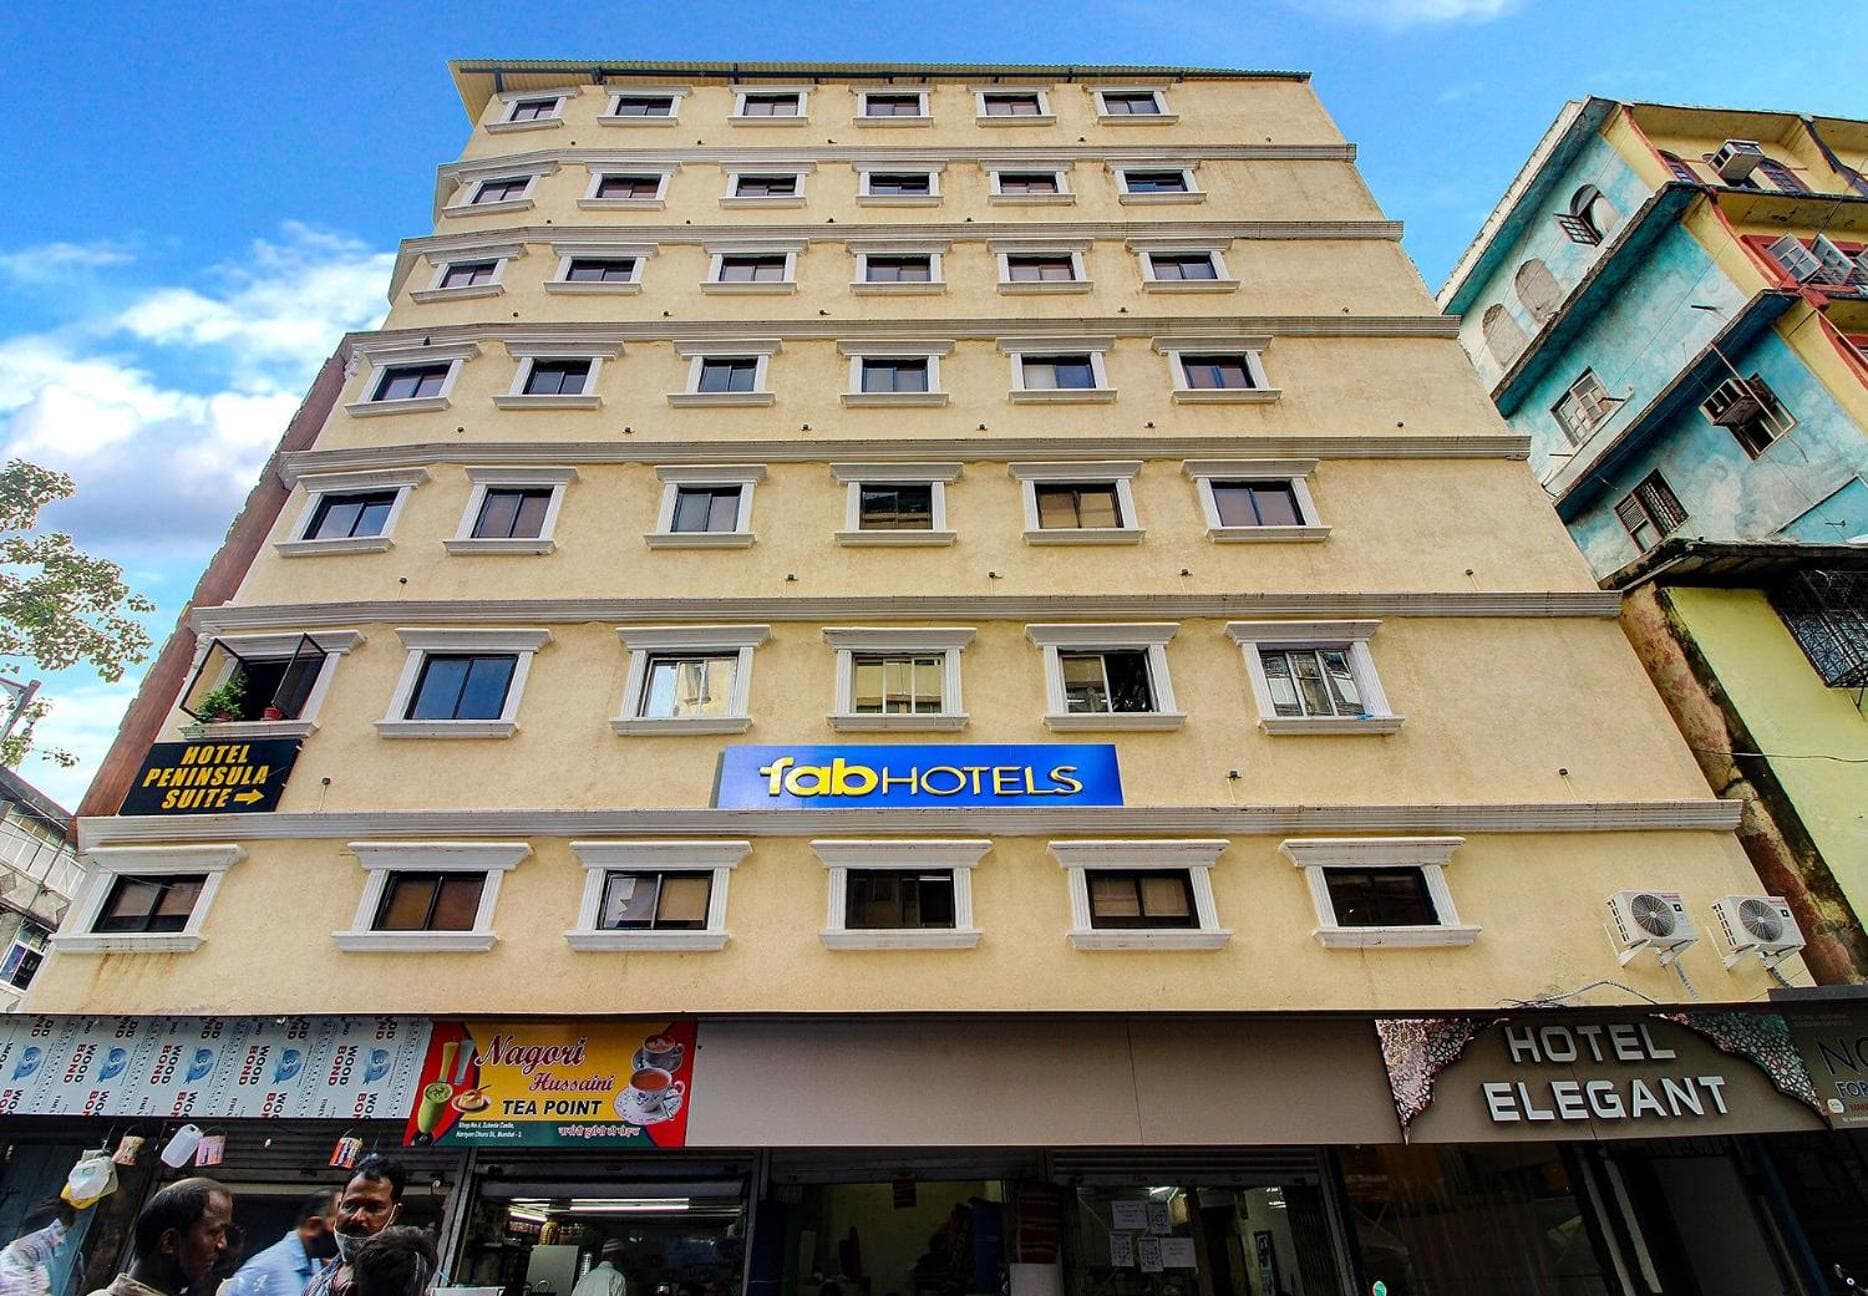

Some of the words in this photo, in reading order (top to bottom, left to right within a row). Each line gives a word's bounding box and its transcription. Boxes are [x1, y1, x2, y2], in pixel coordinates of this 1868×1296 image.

[180, 744, 250, 765] HOTEL
[142, 765, 270, 788] PENINSULA
[161, 788, 233, 809] SUITE
[63, 1043, 87, 1083] BOND
[75, 1043, 98, 1083] WOOD
[475, 1033, 589, 1074] Nagori
[1503, 1023, 1676, 1064] HOTEL
[150, 1044, 172, 1084] BOND
[161, 1044, 184, 1084] WOOD
[238, 1045, 259, 1085] BOND
[249, 1045, 271, 1085] WOOD
[328, 1045, 348, 1086] BOND
[339, 1045, 359, 1085] WOOD
[529, 1072, 615, 1092] Hussaini
[502, 1100, 537, 1115] TEA
[543, 1100, 602, 1115] POINT
[1481, 1075, 1726, 1122] ELEGANT
